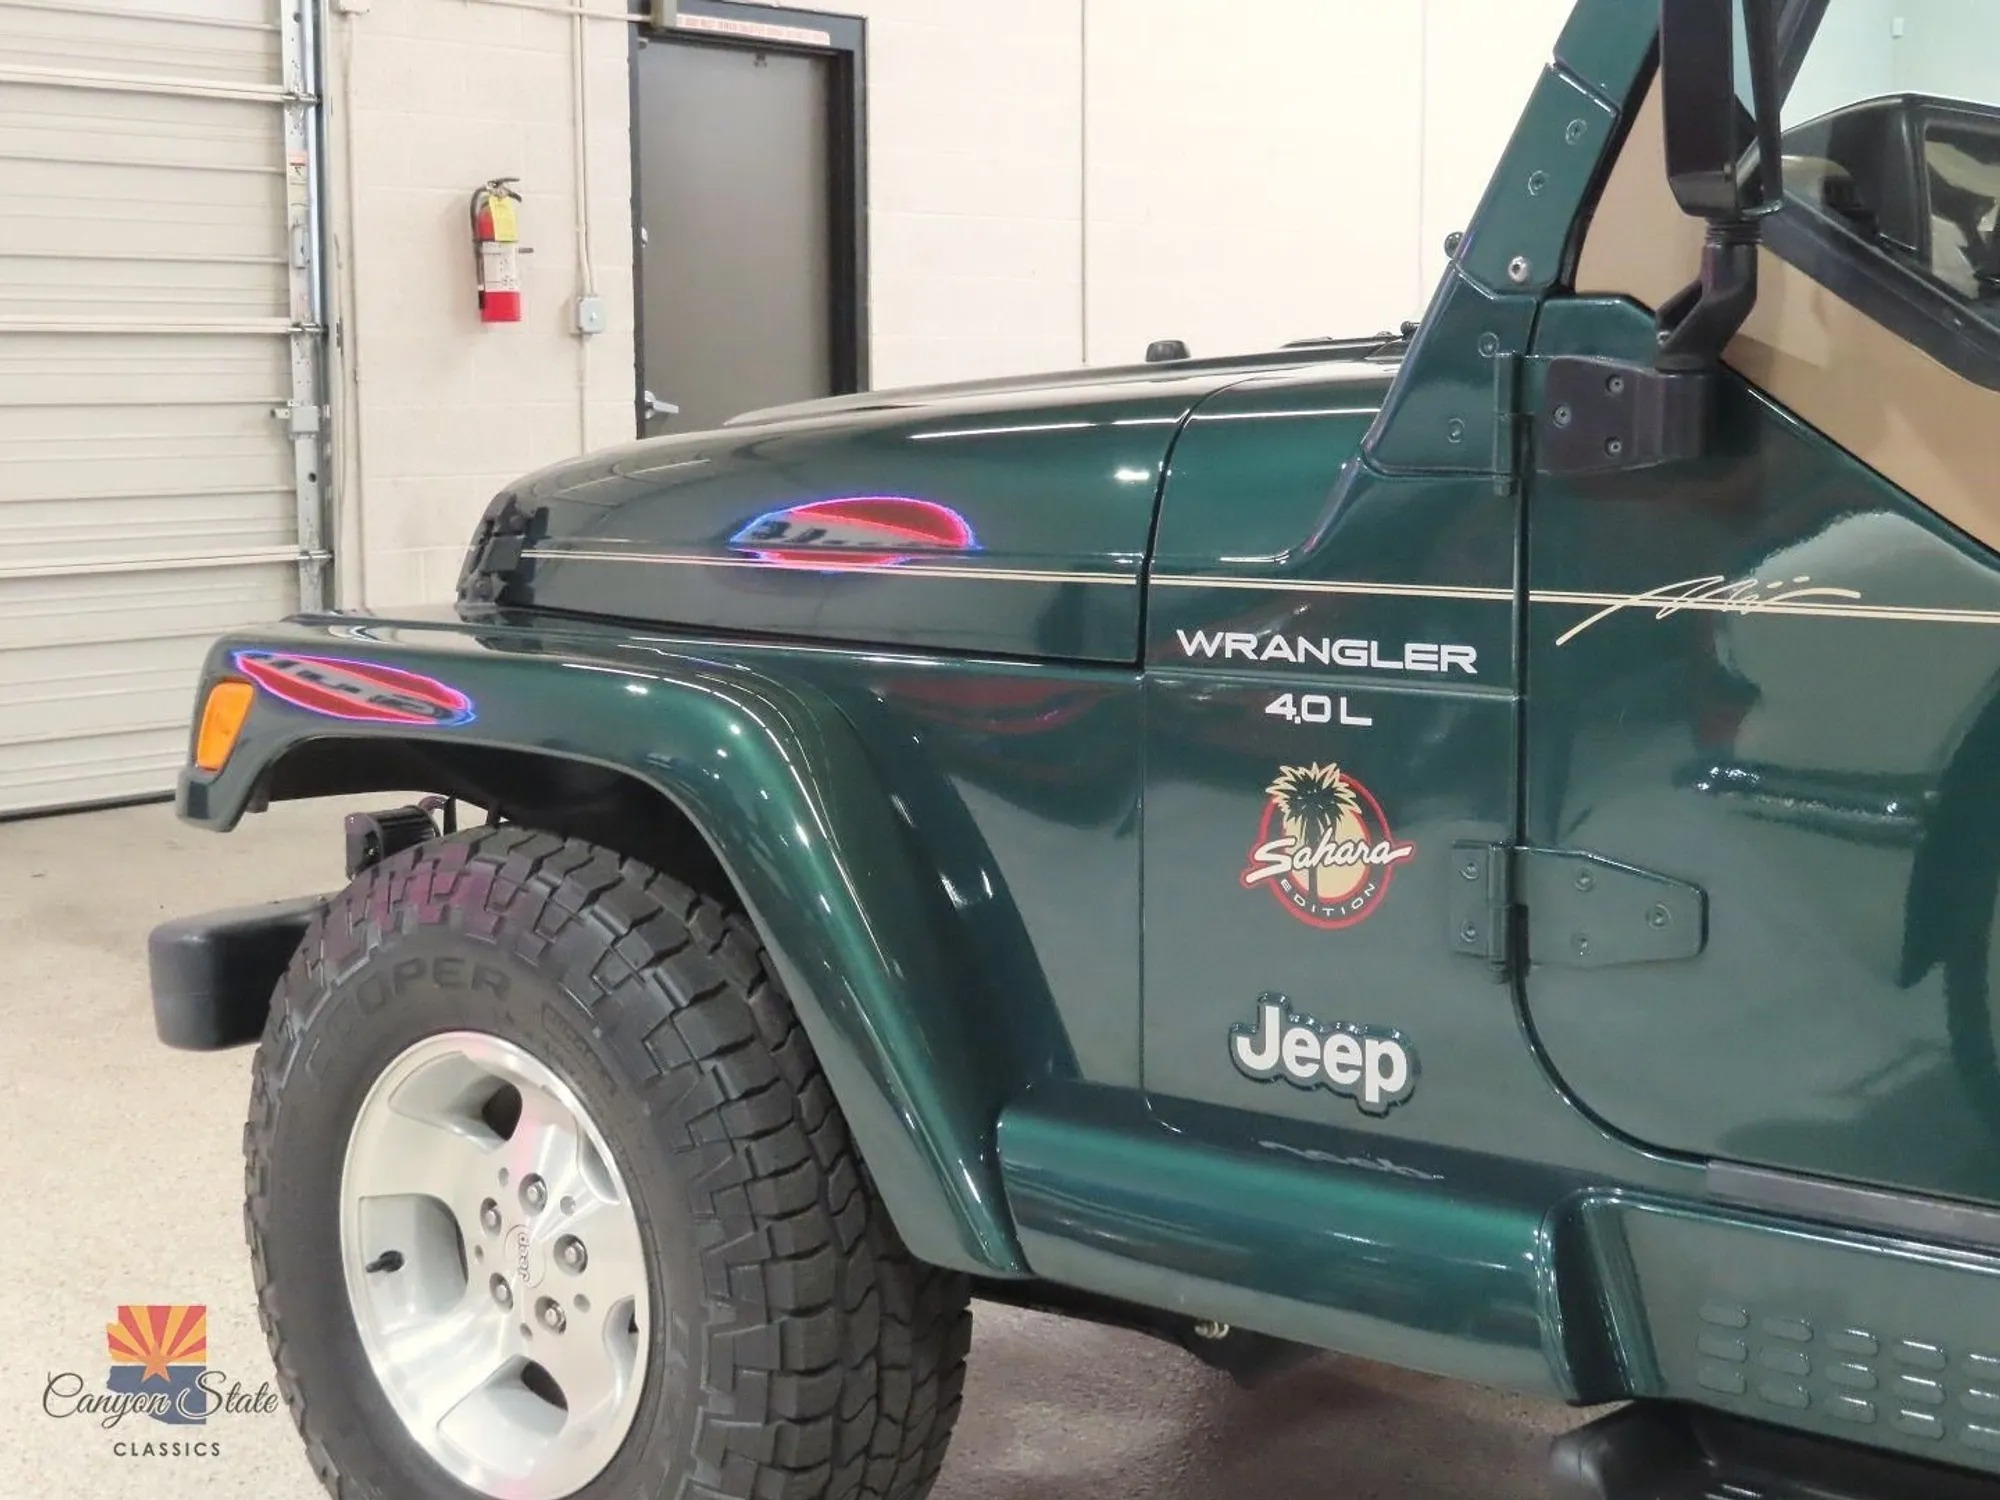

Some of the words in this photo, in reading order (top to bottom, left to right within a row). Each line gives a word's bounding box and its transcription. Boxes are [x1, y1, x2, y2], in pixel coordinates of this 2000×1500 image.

[1176, 629, 1478, 674] WRANGLER
[1246, 827, 1413, 884] Sahara
[1280, 878, 1377, 917] EDITION
[1236, 1005, 1408, 1103] Jeep
[517, 1231, 531, 1283] Jeep
